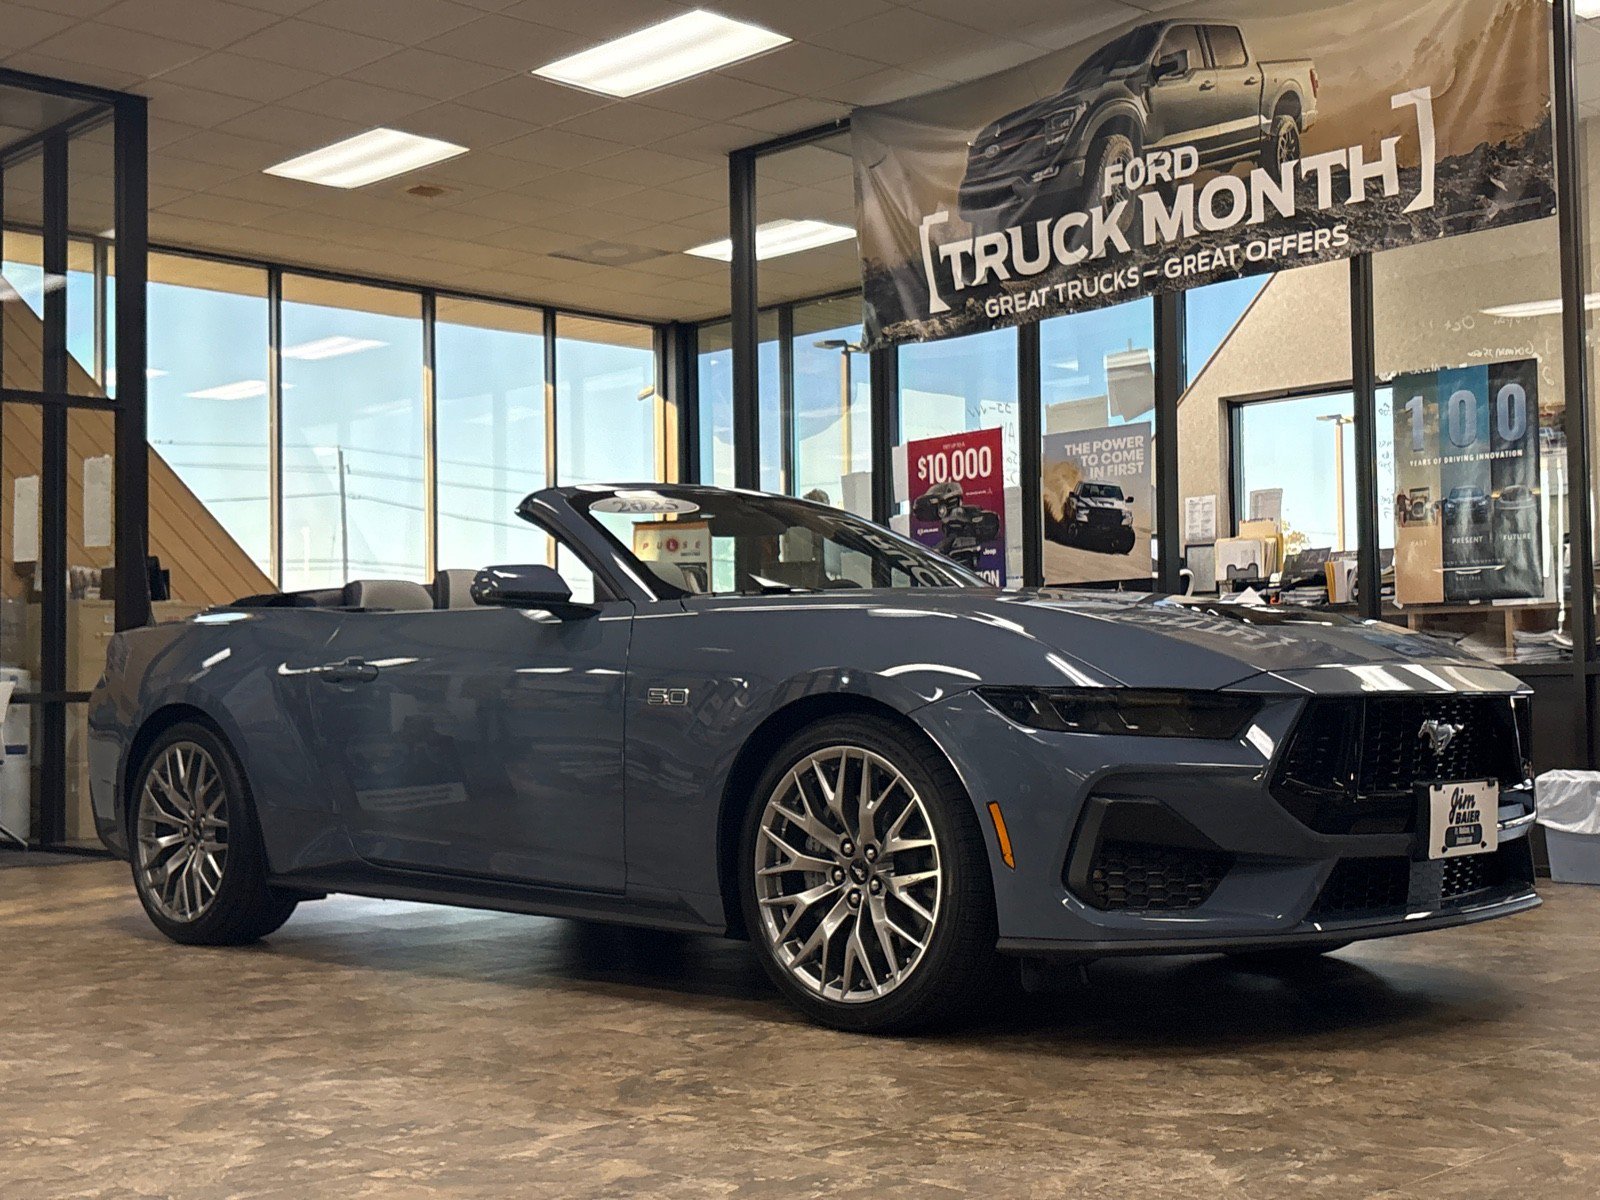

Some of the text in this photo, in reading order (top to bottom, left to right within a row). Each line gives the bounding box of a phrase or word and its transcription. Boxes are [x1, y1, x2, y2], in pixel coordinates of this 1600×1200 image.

[1102, 144, 1199, 199] FORD
[937, 135, 1402, 292] TRUCK MONTH
[984, 281, 1050, 320] GREAT
[1054, 267, 1140, 307] TRUCKS
[1163, 246, 1236, 279] GREAT
[1245, 224, 1350, 262] OFFERS
[1404, 383, 1527, 452] 100
[1064, 435, 1144, 456] THE POWER
[1081, 448, 1144, 466] TO COME
[1409, 449, 1523, 467] YEARS OF DRIVING INNOVATION
[917, 445, 992, 485] $10,000
[1089, 461, 1144, 479] IN FIRST
[1451, 535, 1484, 545] PRESENT
[1502, 532, 1532, 541] FUTURE
[1448, 787, 1476, 825] Jim
[1455, 810, 1480, 824] BAIER
